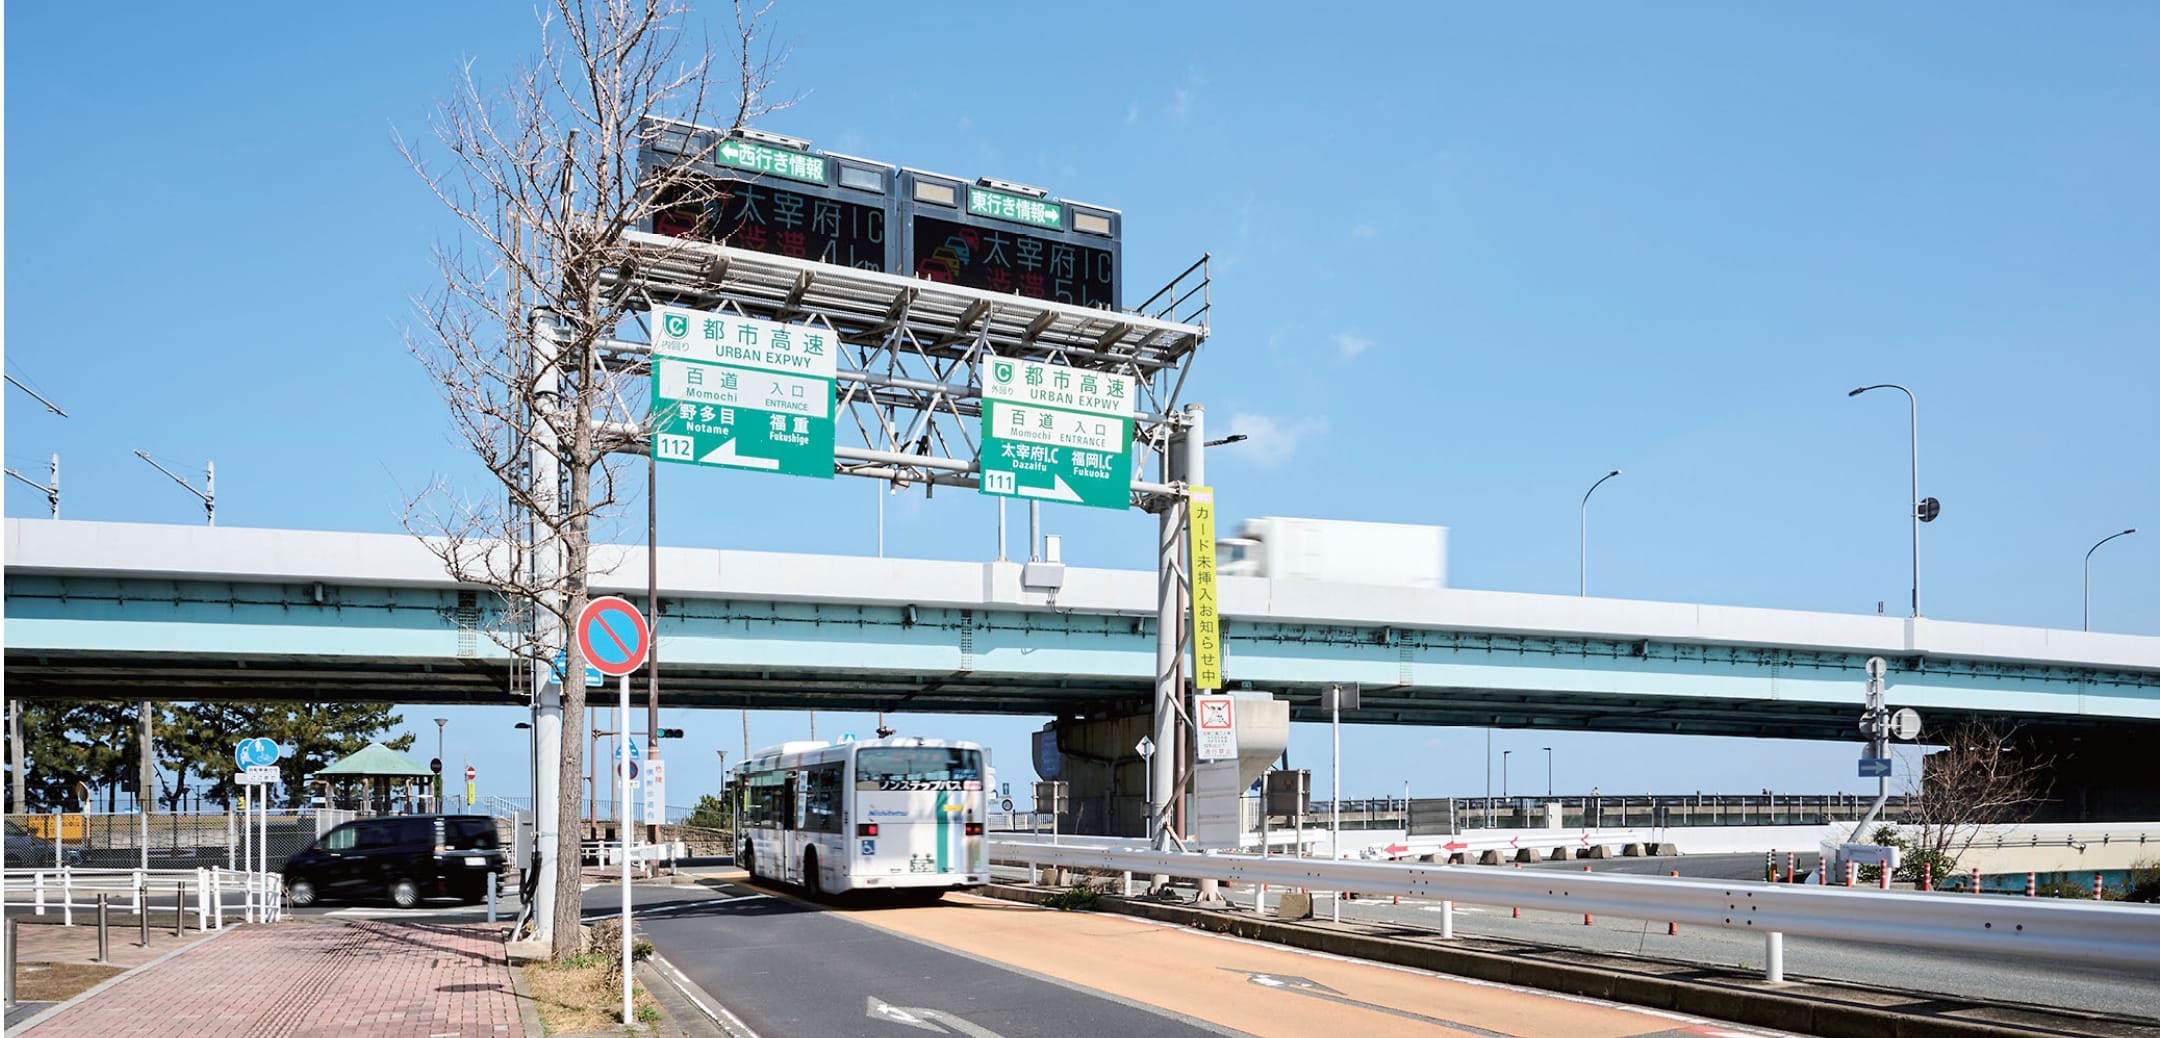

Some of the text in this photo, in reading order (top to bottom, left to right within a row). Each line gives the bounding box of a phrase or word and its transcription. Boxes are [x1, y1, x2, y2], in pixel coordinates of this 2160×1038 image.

[738, 144, 824, 181] 西行き情報
[971, 191, 1047, 223] 東行き情報
[982, 231, 1112, 284] 太宰府IC
[703, 318, 824, 356] 都市高速
[715, 344, 812, 368] URBAN EXPWY
[686, 366, 804, 398] 百道 入口
[1025, 365, 1125, 399] 都市高速
[686, 387, 808, 412] Momochi ENTRANCE
[1030, 388, 1120, 411] URBAN EXPWY
[679, 403, 810, 435] 野多目 福重
[1011, 408, 1106, 436] 百道 入口
[686, 421, 810, 446] Notame Fukushige
[1010, 427, 1107, 448] Momochi ENTRANCE
[662, 438, 690, 457] 112
[987, 474, 1012, 490] 111
[1012, 459, 1110, 479] Dazaifu Fukuoka
[1195, 506, 1216, 683] カード未挿入お知らせ中
[880, 780, 962, 791] ノンステップバス
